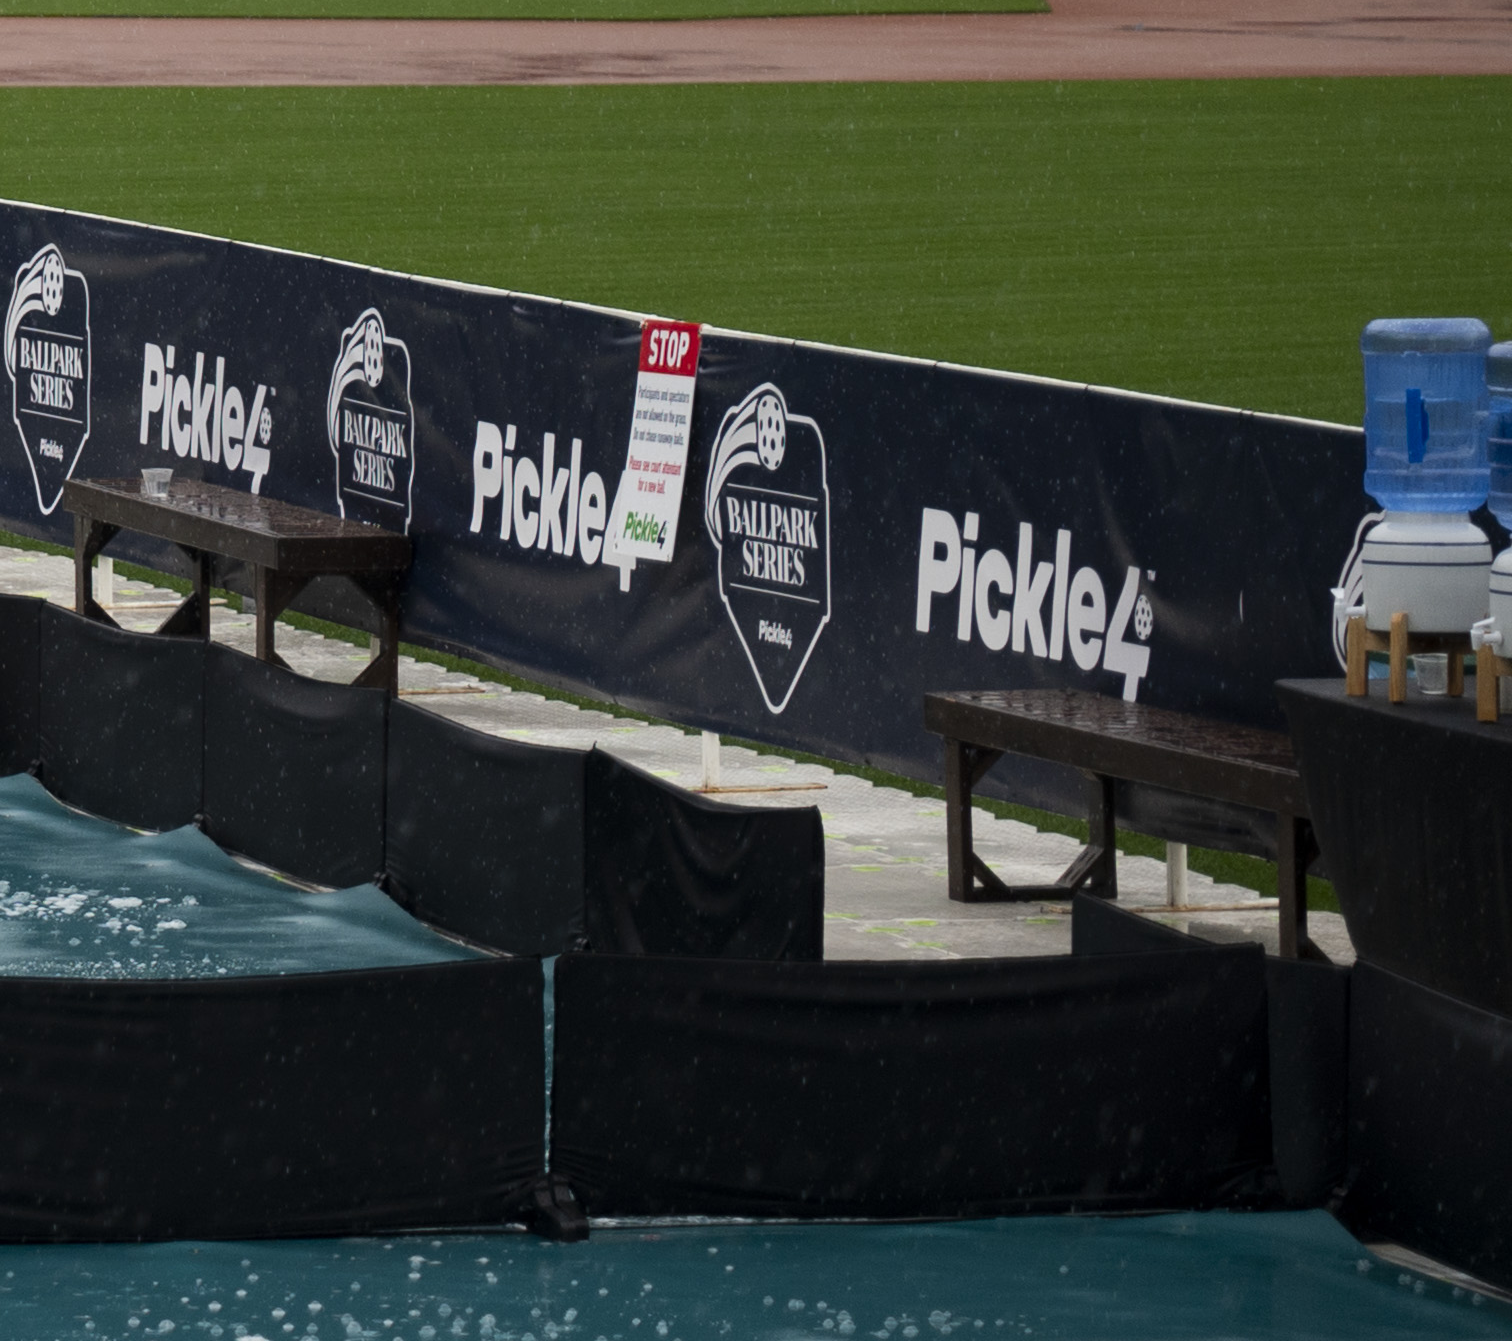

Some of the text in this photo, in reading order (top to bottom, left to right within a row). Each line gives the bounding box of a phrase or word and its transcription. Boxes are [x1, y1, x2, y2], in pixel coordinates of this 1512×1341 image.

[19, 337, 84, 380] BALLPARK
[648, 329, 690, 368] STOP
[30, 372, 74, 412] SERIES
[139, 342, 272, 494] Pickle4
[343, 407, 407, 459] BALLPARK
[353, 454, 396, 492] SERIES
[623, 512, 668, 550] Pickle4
[725, 495, 819, 550] BALLPARK
[741, 546, 807, 587] SERIES
[917, 507, 1154, 702] Pickle4
[758, 619, 793, 651] Pickle4
